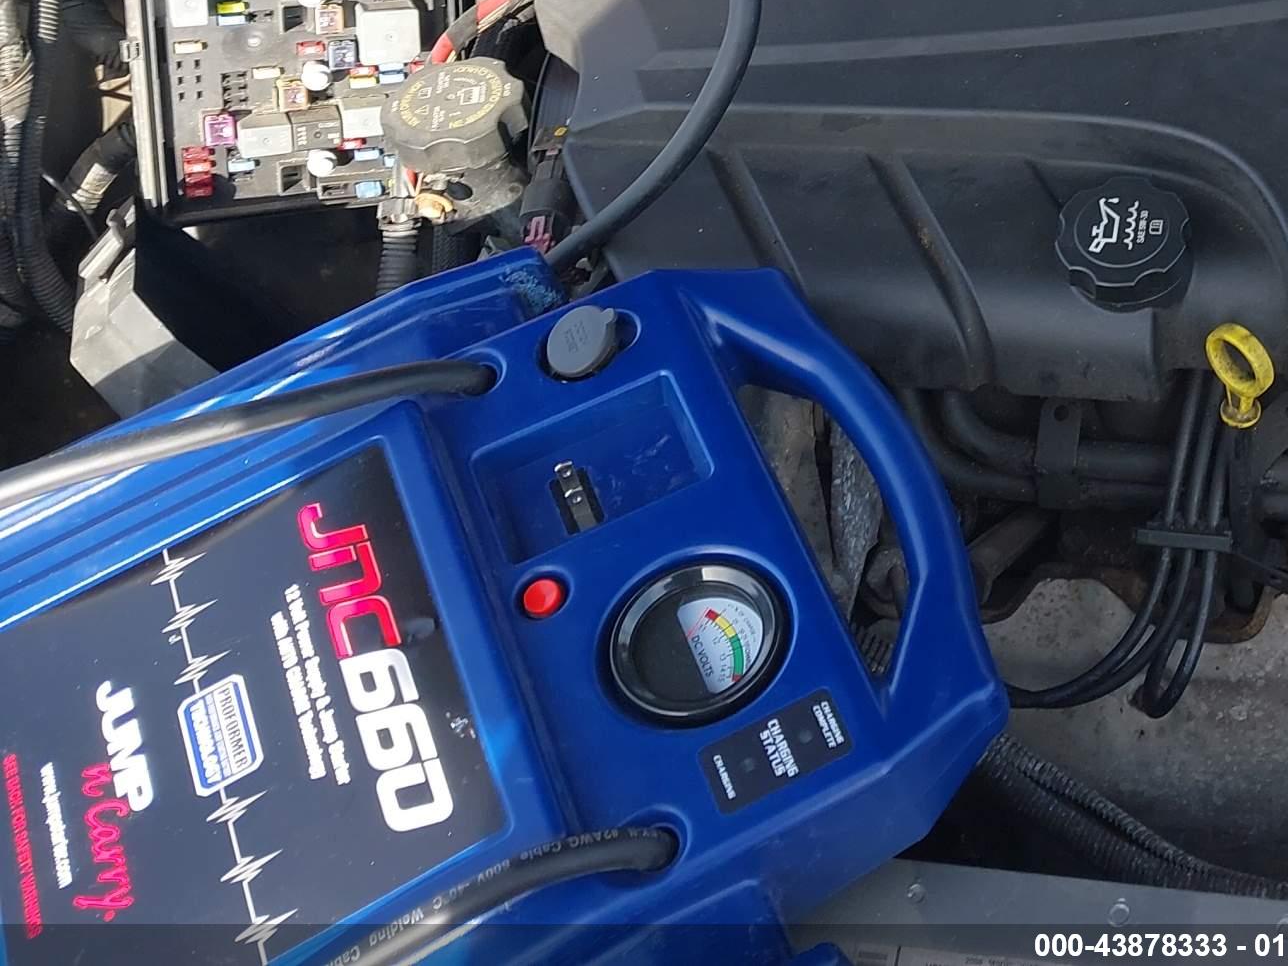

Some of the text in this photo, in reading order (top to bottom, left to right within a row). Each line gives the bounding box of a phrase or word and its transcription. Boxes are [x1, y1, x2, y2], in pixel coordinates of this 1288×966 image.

[284, 584, 300, 603] 12
[297, 503, 454, 832] JNC660
[691, 635, 714, 677] DC VOLTS
[219, 687, 248, 768] PROFORMER
[812, 705, 837, 748] COMPLETE
[821, 701, 845, 744] CHARGING
[96, 681, 154, 811] JUMP
[760, 729, 786, 777] STATUS
[767, 718, 799, 777] CHARGING
[713, 754, 736, 799] CHARGING
